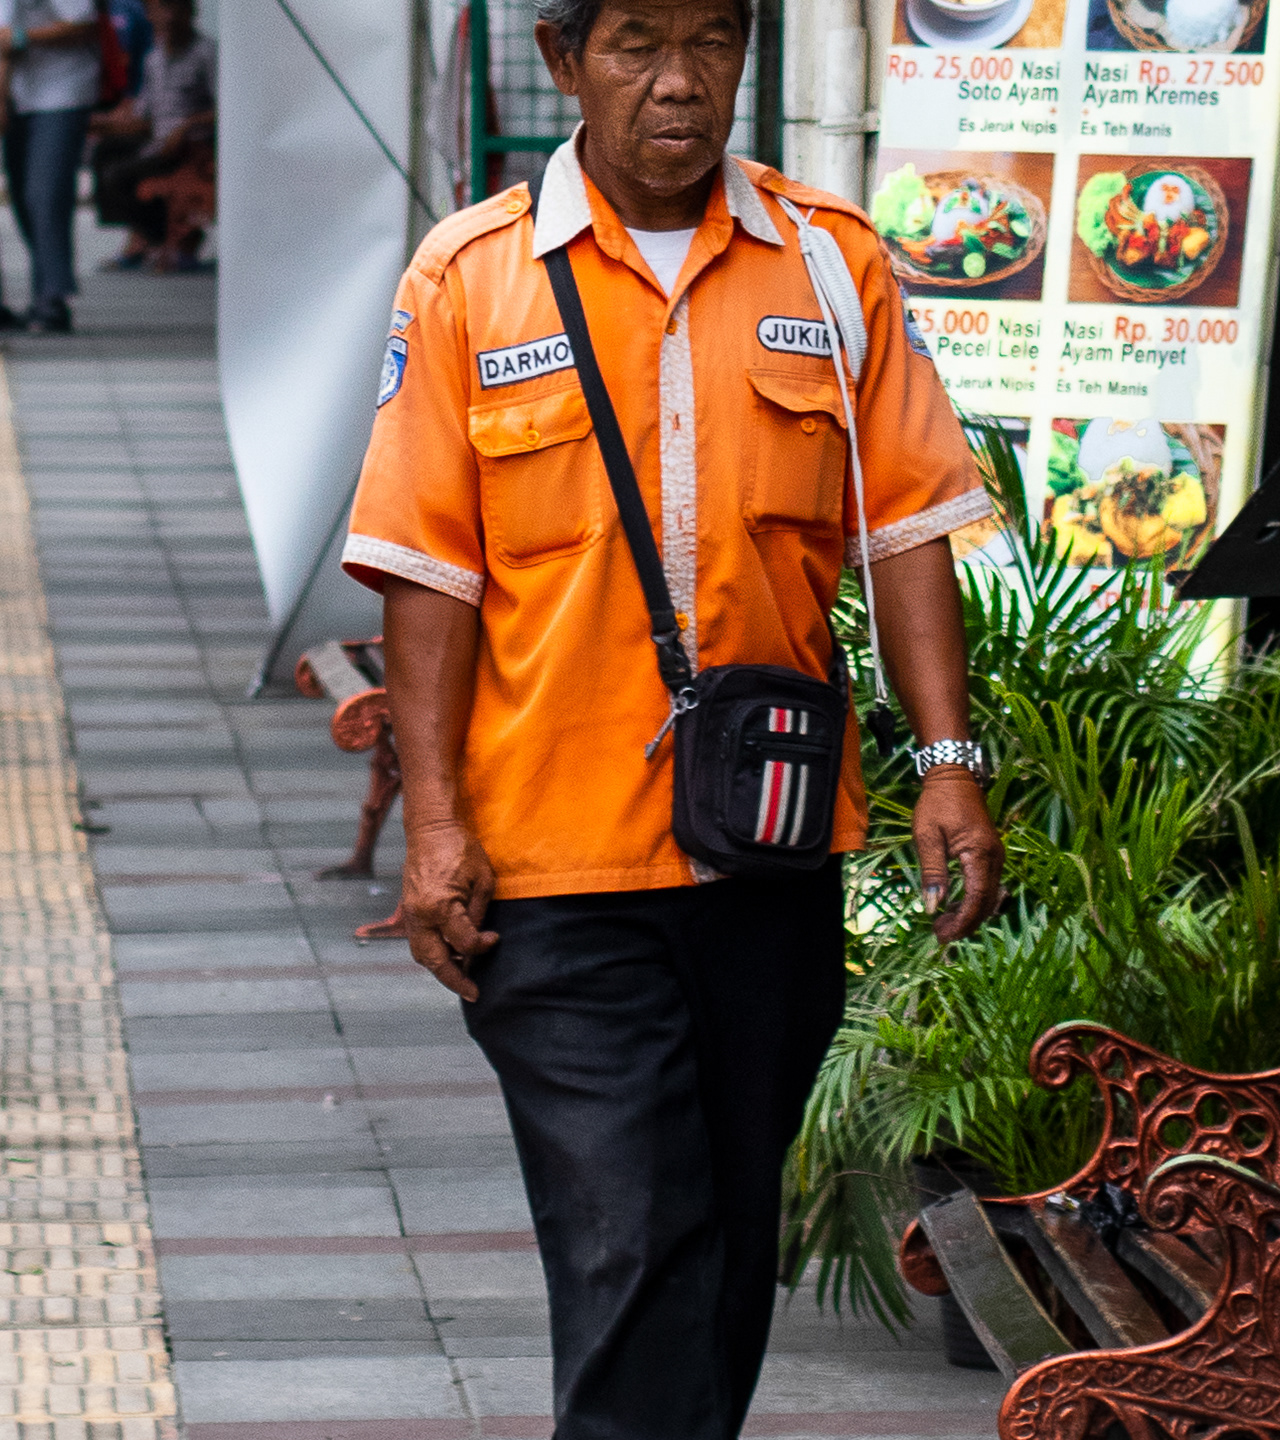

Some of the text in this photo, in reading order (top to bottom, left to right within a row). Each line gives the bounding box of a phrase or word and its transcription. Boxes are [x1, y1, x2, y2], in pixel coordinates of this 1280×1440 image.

[888, 54, 1061, 83] Rp. 25.000 Nasi
[1085, 60, 1264, 87] Nasi Rp. 27.500
[958, 80, 1059, 106] Soto Ayam
[1083, 84, 1219, 108] Ayam Kremes
[959, 118, 1058, 136] Es Jeruk Nipis
[1081, 121, 1172, 137] Es Teh Manis
[999, 319, 1041, 337] Nasi
[1063, 316, 1238, 345] Nasi Rp. 30.000
[937, 336, 990, 356] Pecel
[998, 339, 1039, 359] Lele
[1061, 342, 1186, 369] Ayam Penyet
[485, 342, 568, 379] DARMO
[956, 376, 993, 389] Jeruk
[1000, 377, 1036, 392] Nipis
[1057, 379, 1148, 396] Es Teh Manis
